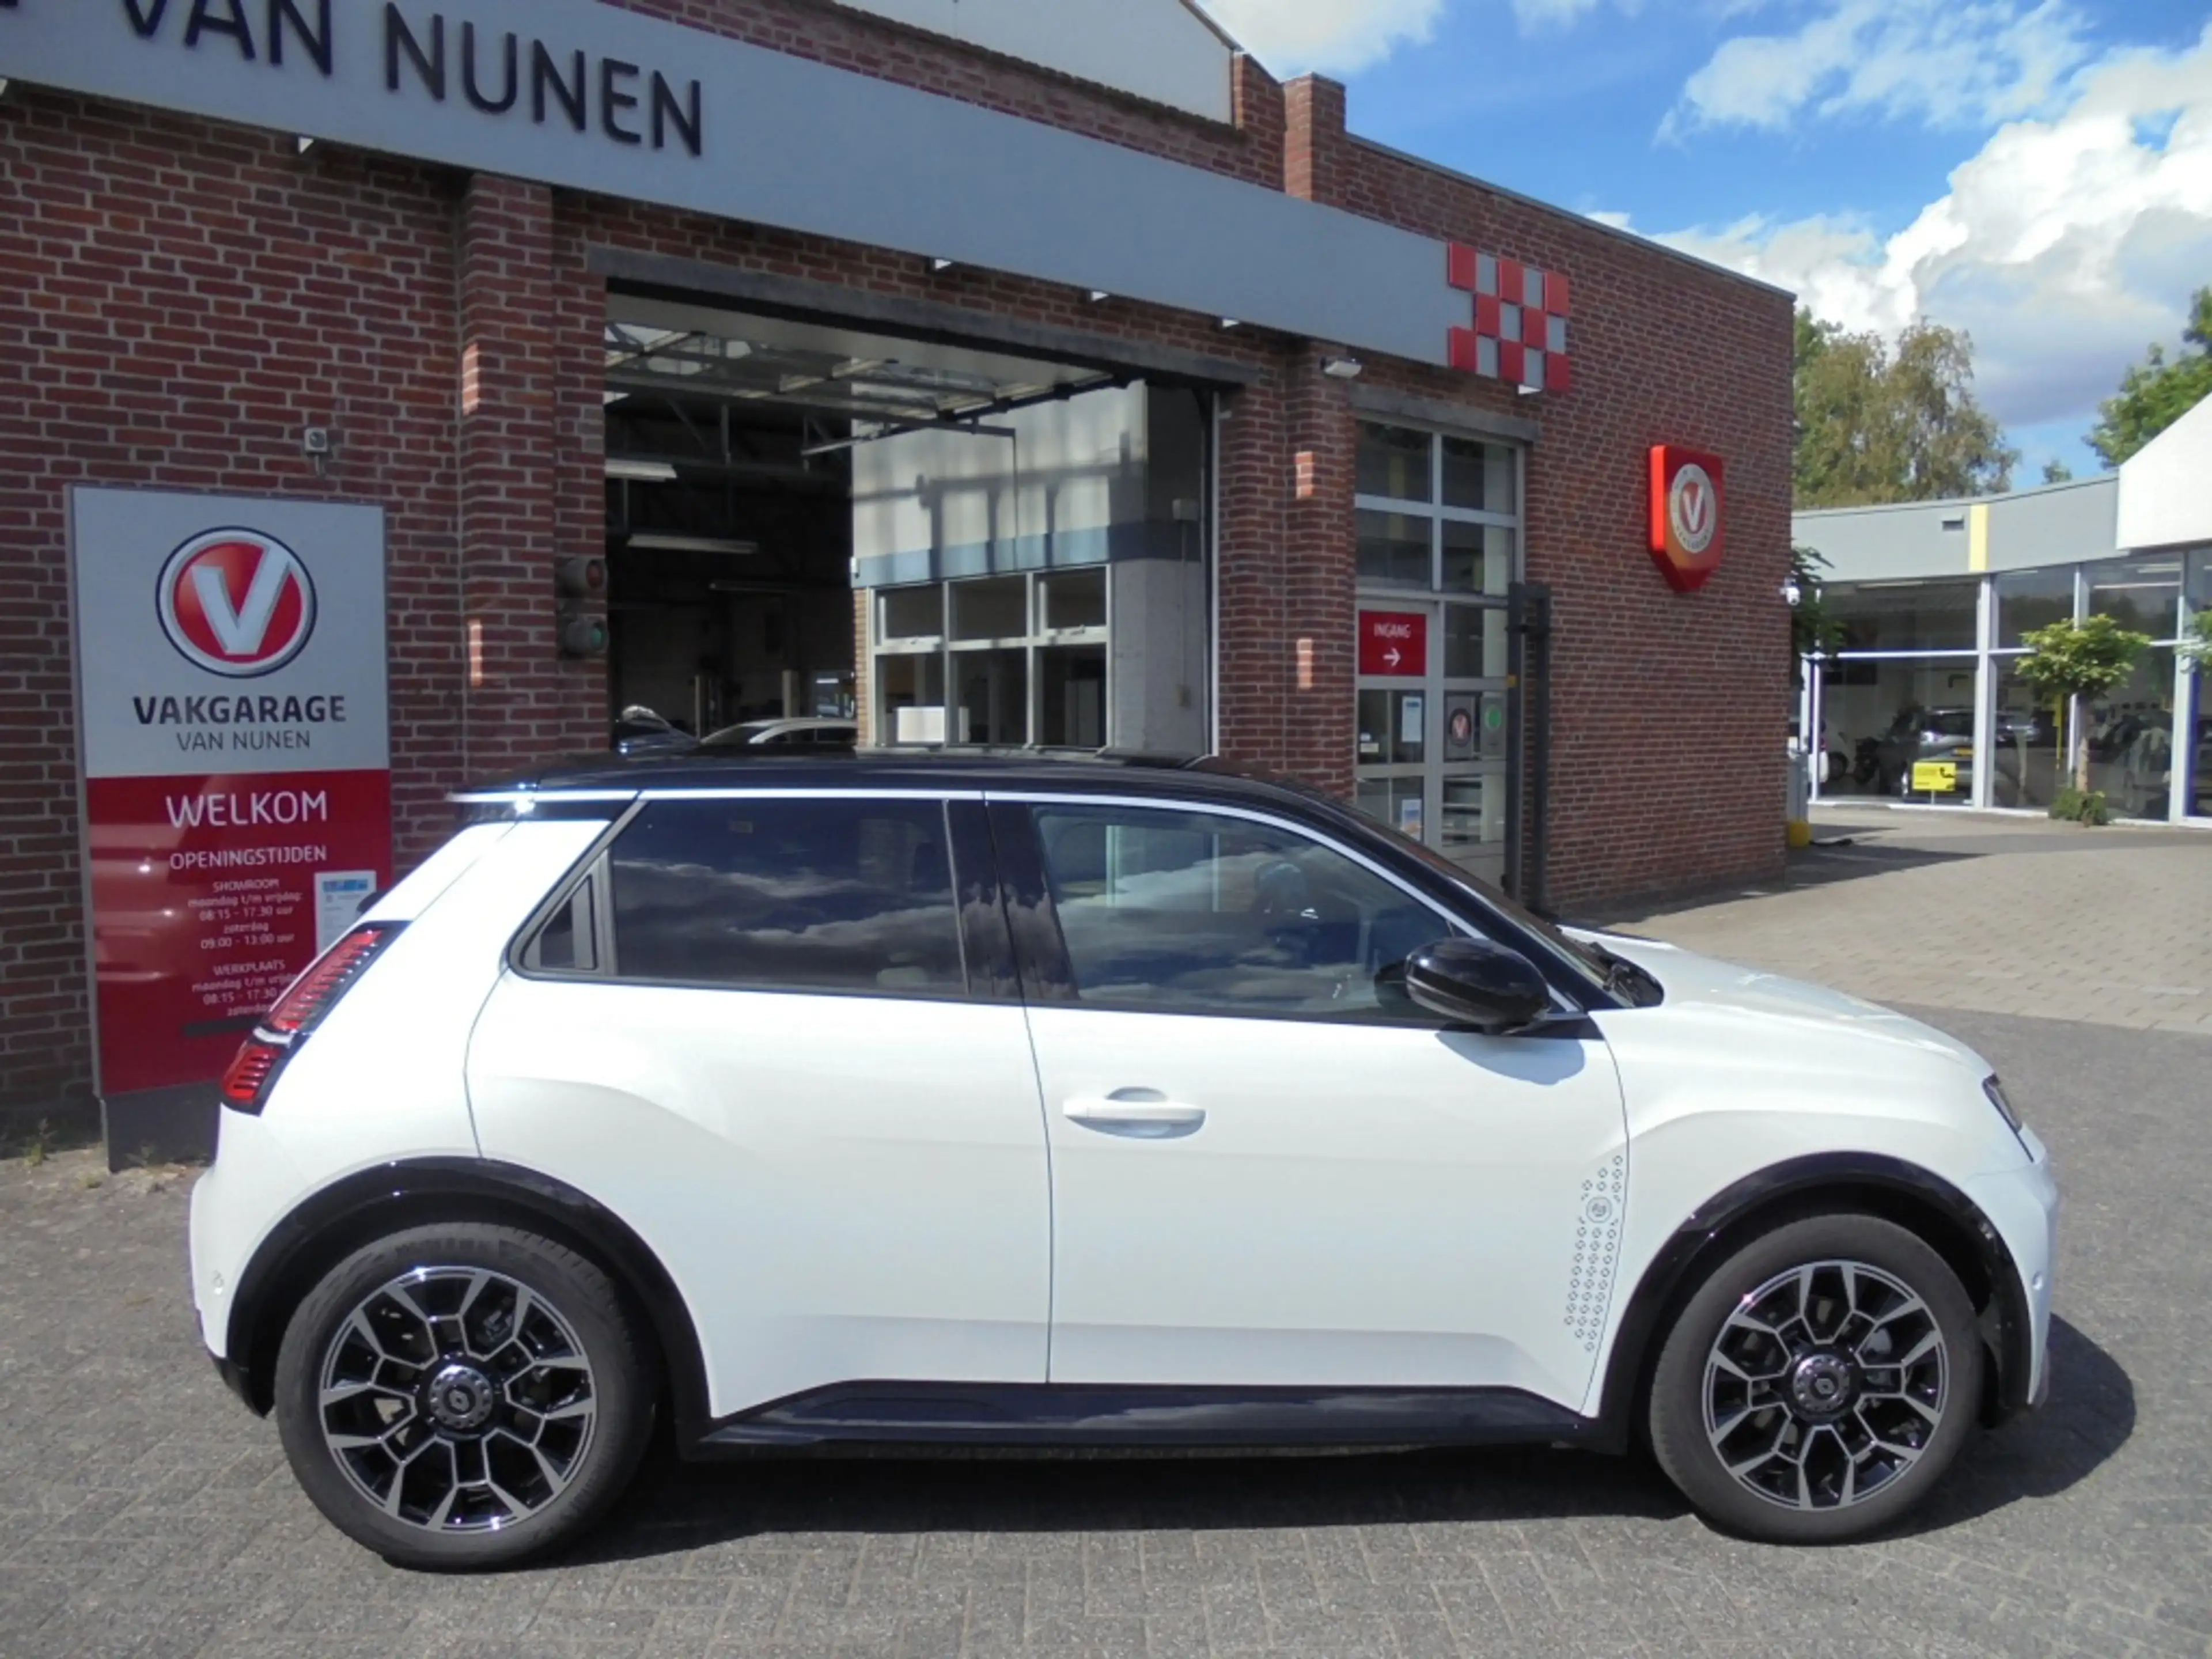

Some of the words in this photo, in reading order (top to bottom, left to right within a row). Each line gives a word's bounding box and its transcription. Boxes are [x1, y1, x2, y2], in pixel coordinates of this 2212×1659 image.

[384, 2, 702, 157] NUNEN
[1373, 622, 1411, 638] INGANG
[132, 695, 347, 725] VAKGARAGE
[176, 732, 224, 752] VAN
[233, 729, 310, 750] NUNEN
[165, 790, 328, 828] WELKOM
[169, 844, 327, 870] OPENINGSTIJDEN
[212, 878, 280, 892] SHOWROOM
[212, 959, 286, 976] WERKPLAATS
